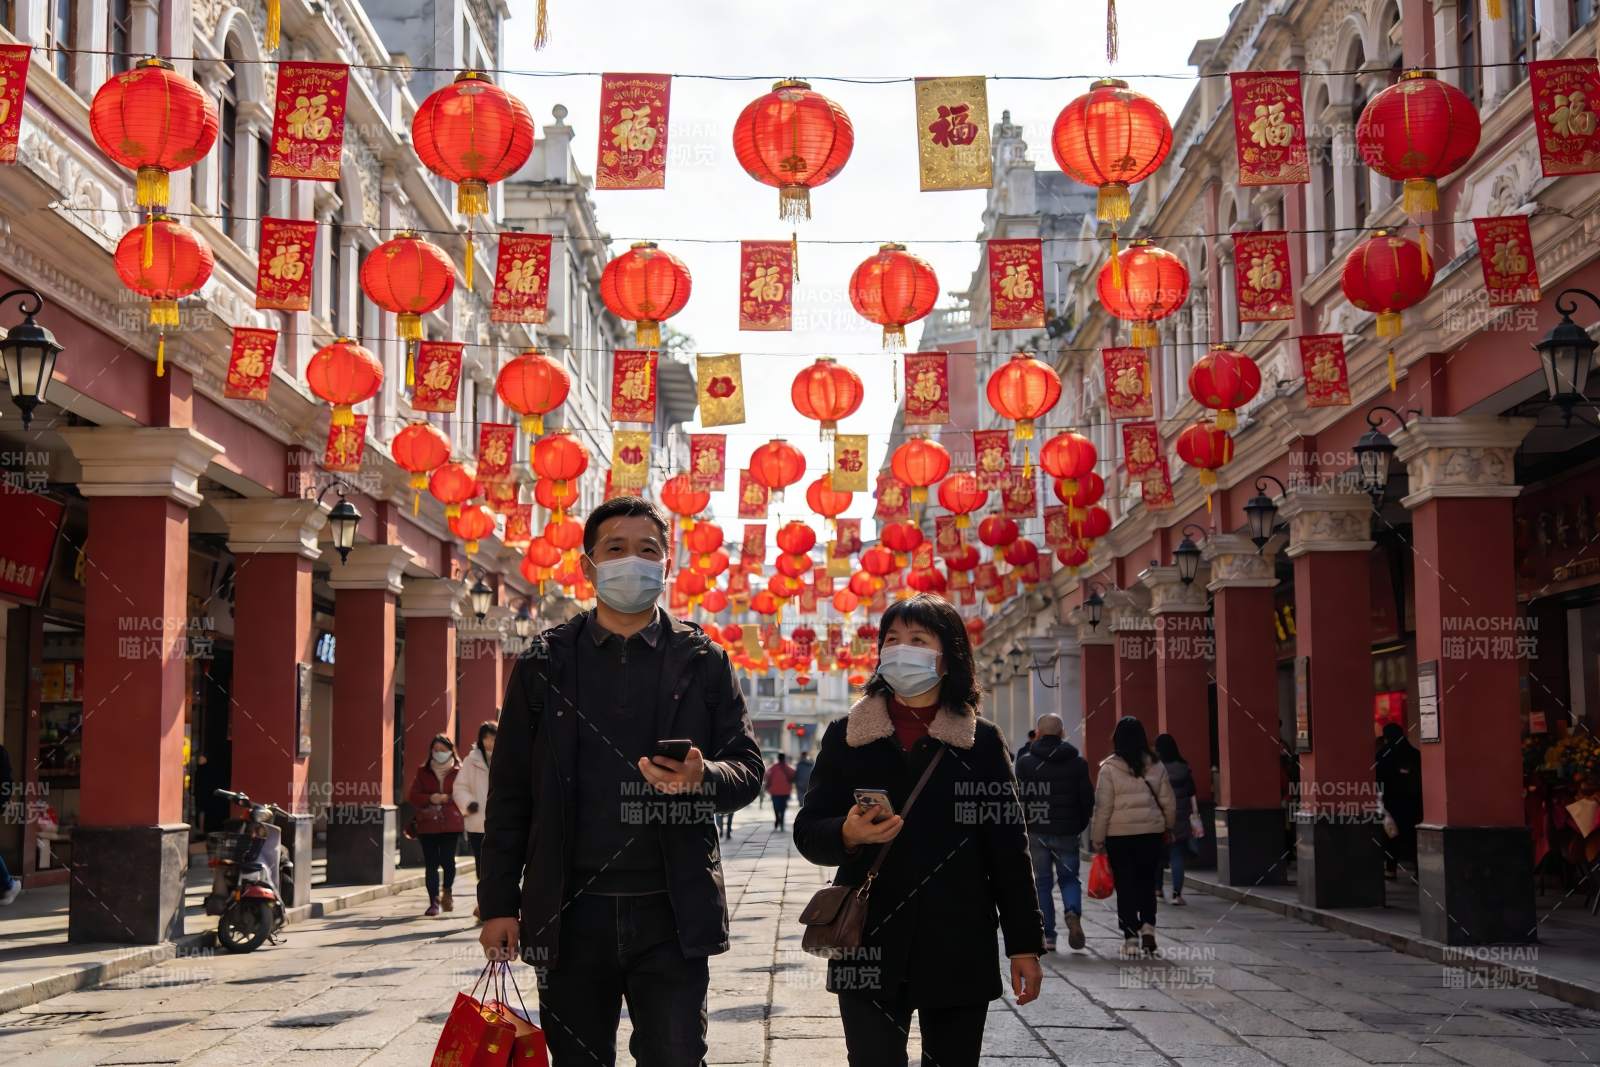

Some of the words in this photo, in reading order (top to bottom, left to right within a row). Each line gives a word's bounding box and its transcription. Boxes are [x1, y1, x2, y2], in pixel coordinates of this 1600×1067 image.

[286, 94, 332, 141] 福
[611, 105, 657, 152] 福
[928, 103, 979, 149] 福
[1248, 102, 1294, 148] 福
[1548, 90, 1597, 138] 福
[268, 244, 305, 281] 福
[504, 258, 540, 294] 福
[1246, 254, 1284, 291] 福
[1494, 239, 1528, 276] 福
[748, 265, 784, 303] 福
[999, 263, 1034, 300] 福
[236, 349, 264, 378] 福
[423, 360, 452, 390] 福
[912, 370, 941, 401] 福
[837, 449, 863, 472] 福
